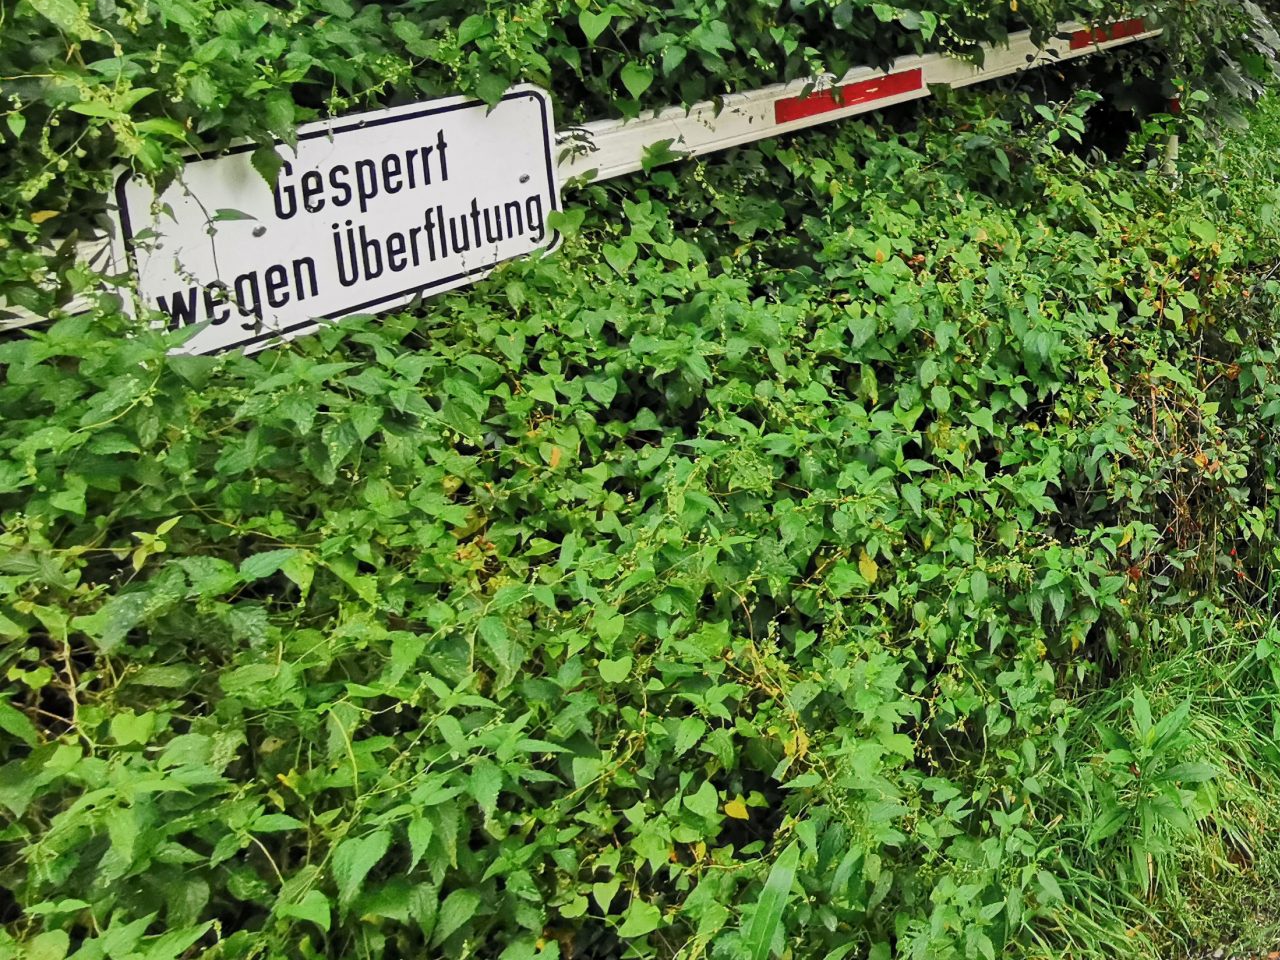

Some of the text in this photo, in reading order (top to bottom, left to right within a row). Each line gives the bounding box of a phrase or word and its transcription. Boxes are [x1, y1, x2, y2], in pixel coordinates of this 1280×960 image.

[274, 128, 449, 221] Gesperrt
[156, 193, 545, 330] wegen Überflutung
